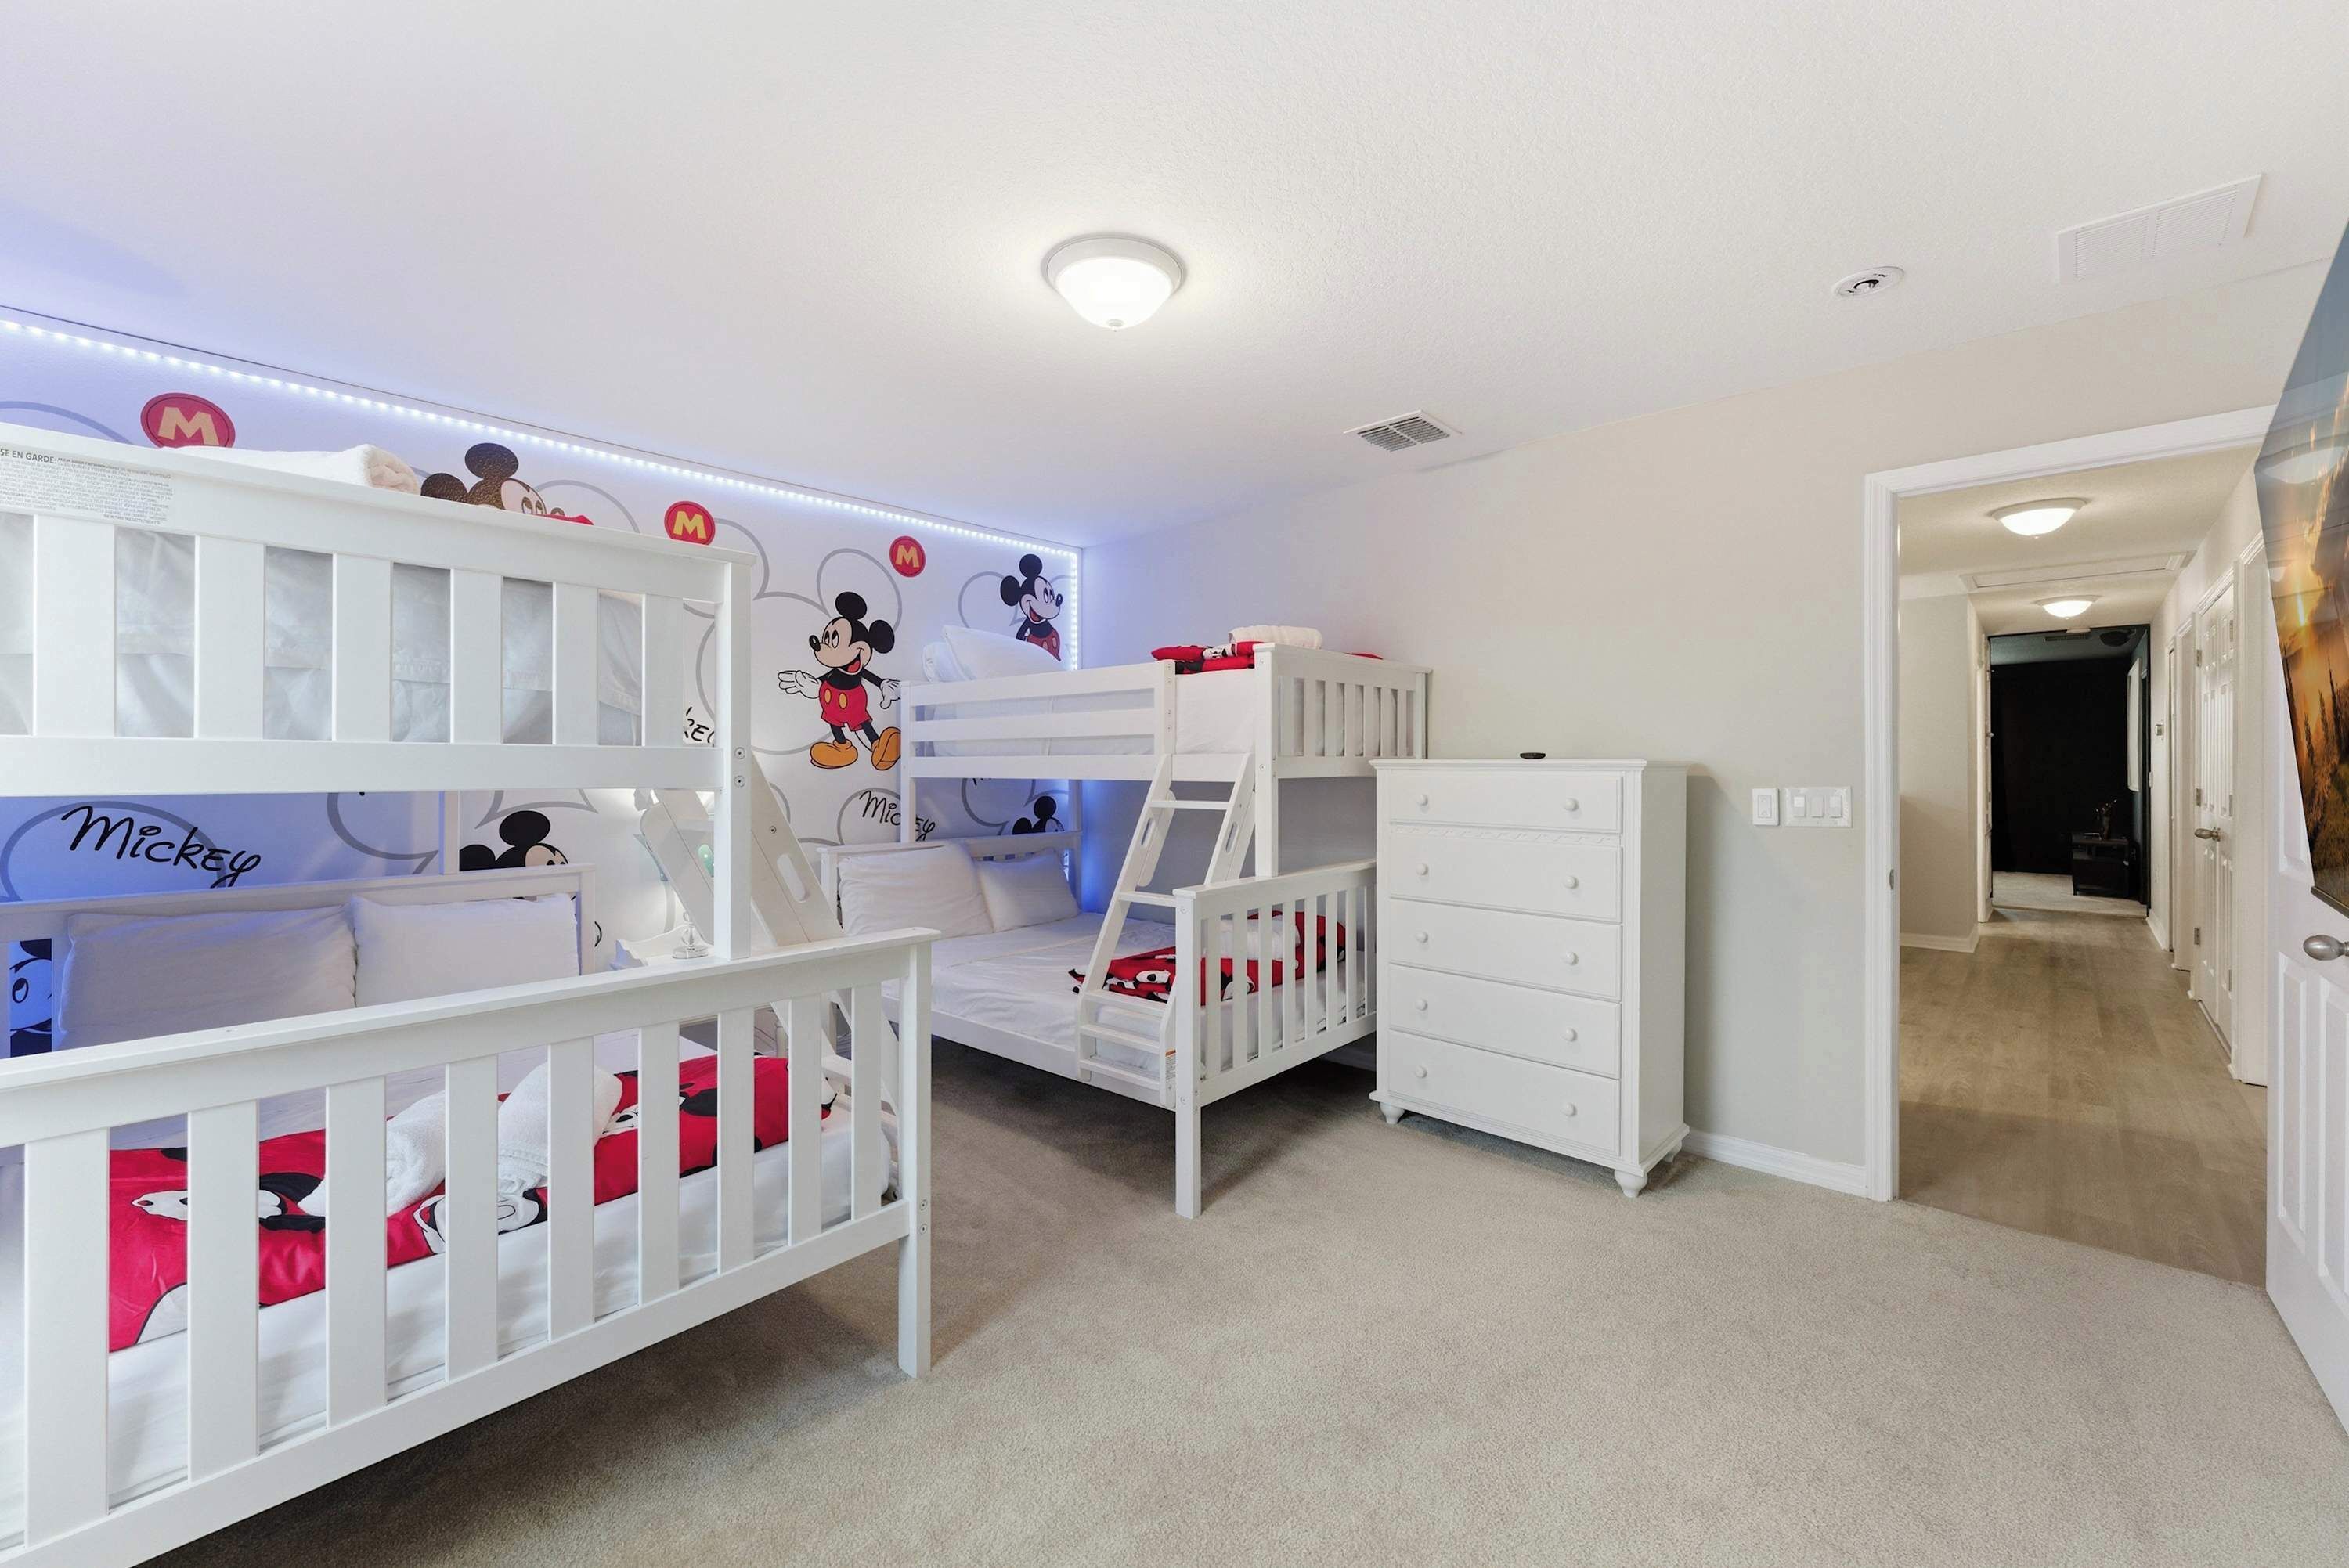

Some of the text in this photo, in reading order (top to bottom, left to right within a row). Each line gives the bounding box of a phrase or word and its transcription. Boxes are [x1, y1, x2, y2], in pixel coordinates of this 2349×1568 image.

[157, 406, 219, 445] M
[673, 510, 707, 539] M
[895, 545, 920, 568] M
